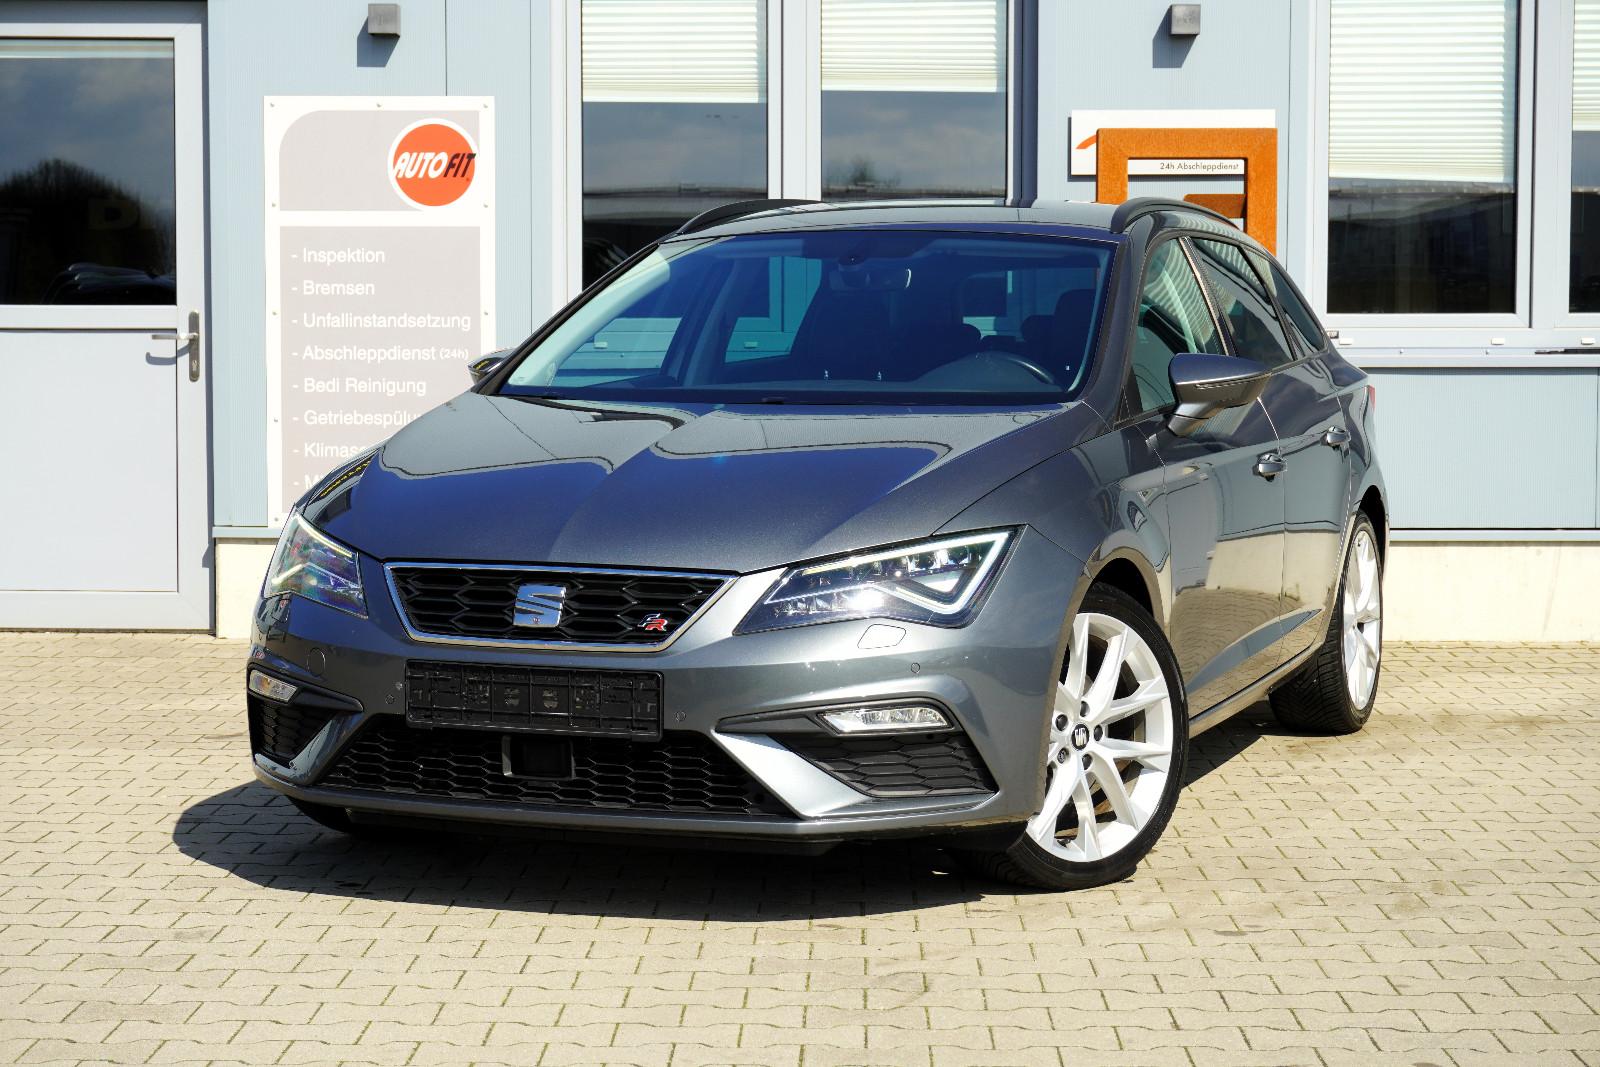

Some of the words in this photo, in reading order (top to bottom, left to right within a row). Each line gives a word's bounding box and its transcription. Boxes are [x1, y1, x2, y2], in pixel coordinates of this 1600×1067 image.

[1160, 161, 1175, 170] 24h
[1177, 161, 1239, 172] Abschleppdienst
[302, 247, 385, 265] Inspektion
[302, 279, 375, 296] Bremsen
[303, 312, 471, 331] Unfallinstandsetzung
[302, 345, 435, 364] Abschleppdienst
[439, 346, 469, 361] (24h)
[303, 377, 340, 393] Bedi
[345, 377, 427, 396] Reinigung
